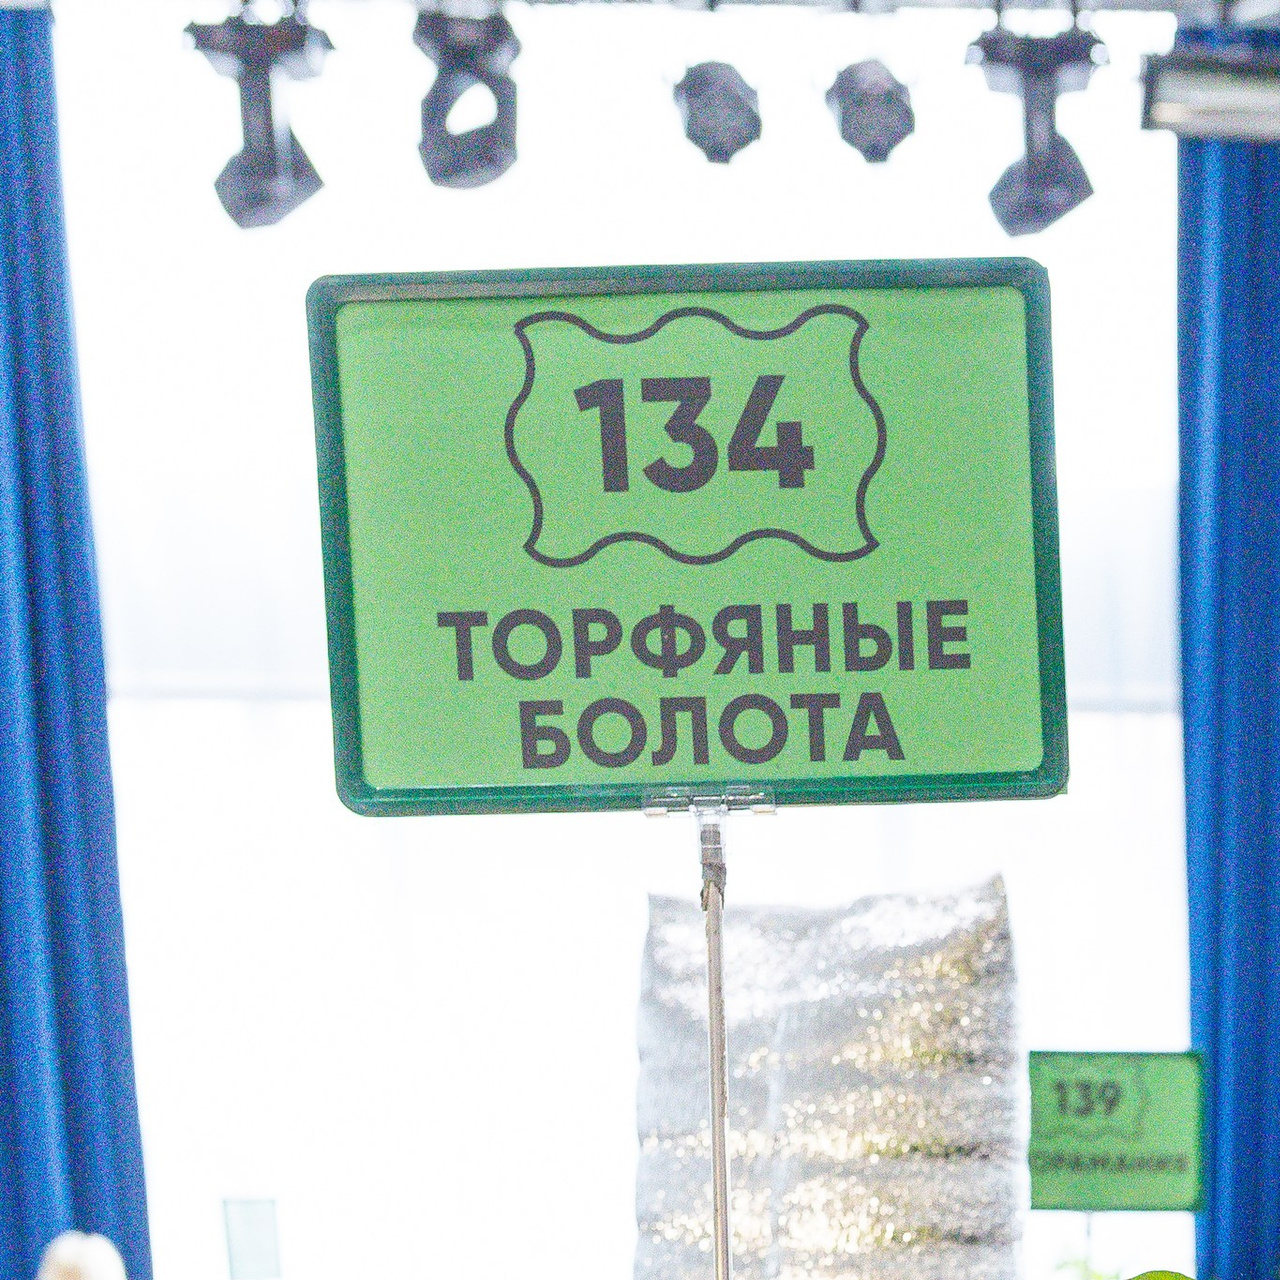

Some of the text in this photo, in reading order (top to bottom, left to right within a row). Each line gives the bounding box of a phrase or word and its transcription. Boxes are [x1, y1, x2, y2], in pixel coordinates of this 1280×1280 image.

[574, 374, 815, 493] 134
[437, 599, 972, 682] ТОРФЯНЫЕ
[518, 692, 906, 770] БОЛОТА
[1054, 1078, 1123, 1117] 139
